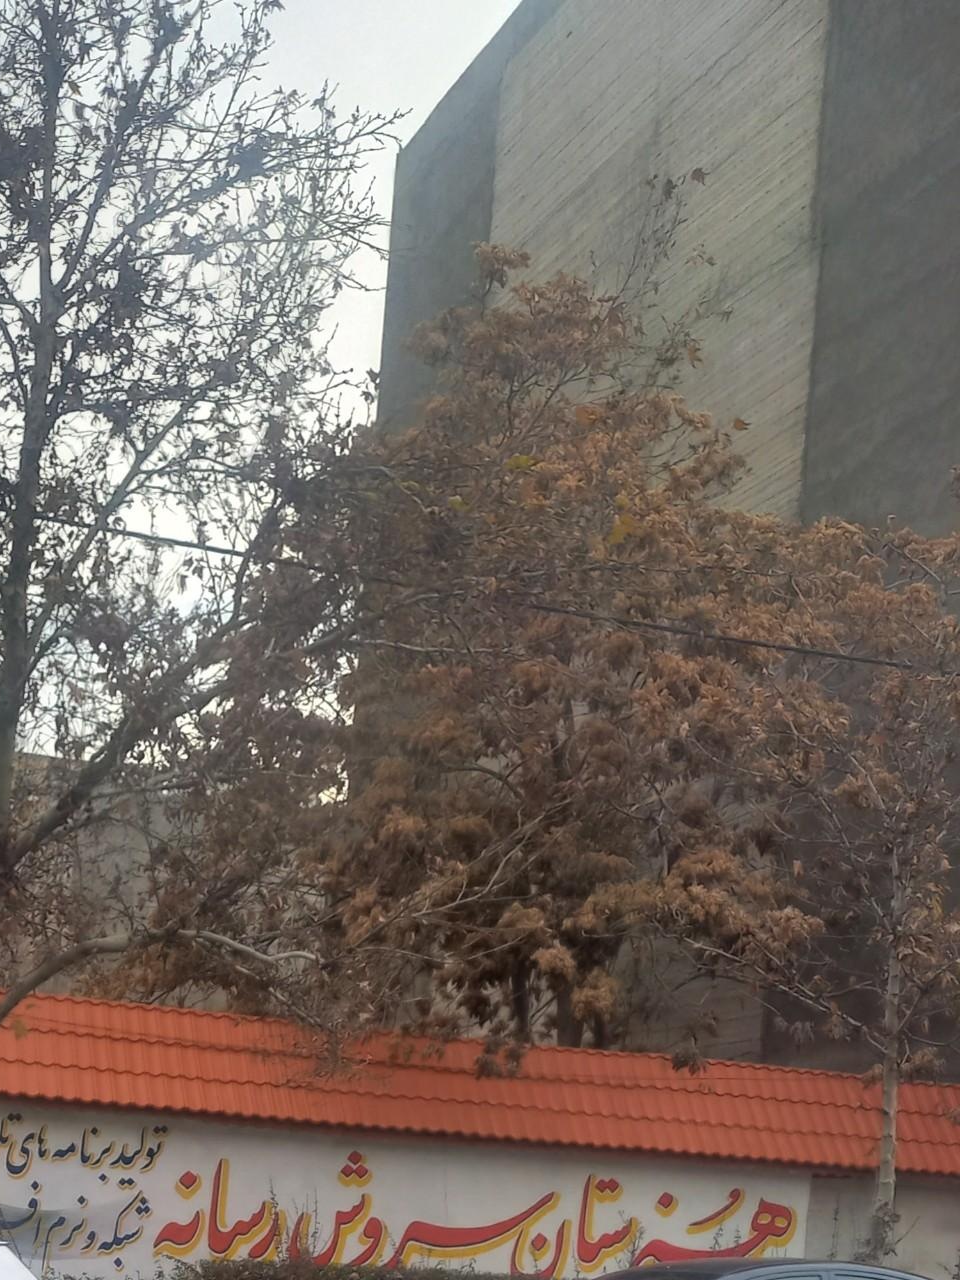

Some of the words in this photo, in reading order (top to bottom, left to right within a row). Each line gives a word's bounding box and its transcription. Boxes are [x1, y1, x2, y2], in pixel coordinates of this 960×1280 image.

[5, 1123, 48, 1178] های
[52, 1126, 115, 1183] برنامه
[111, 1124, 170, 1188] تولید
[42, 1194, 87, 1274] نرم
[80, 1229, 96, 1252] و
[96, 1189, 152, 1271] شبکه
[153, 1158, 286, 1263] رسانه
[289, 1151, 559, 1270] سروش
